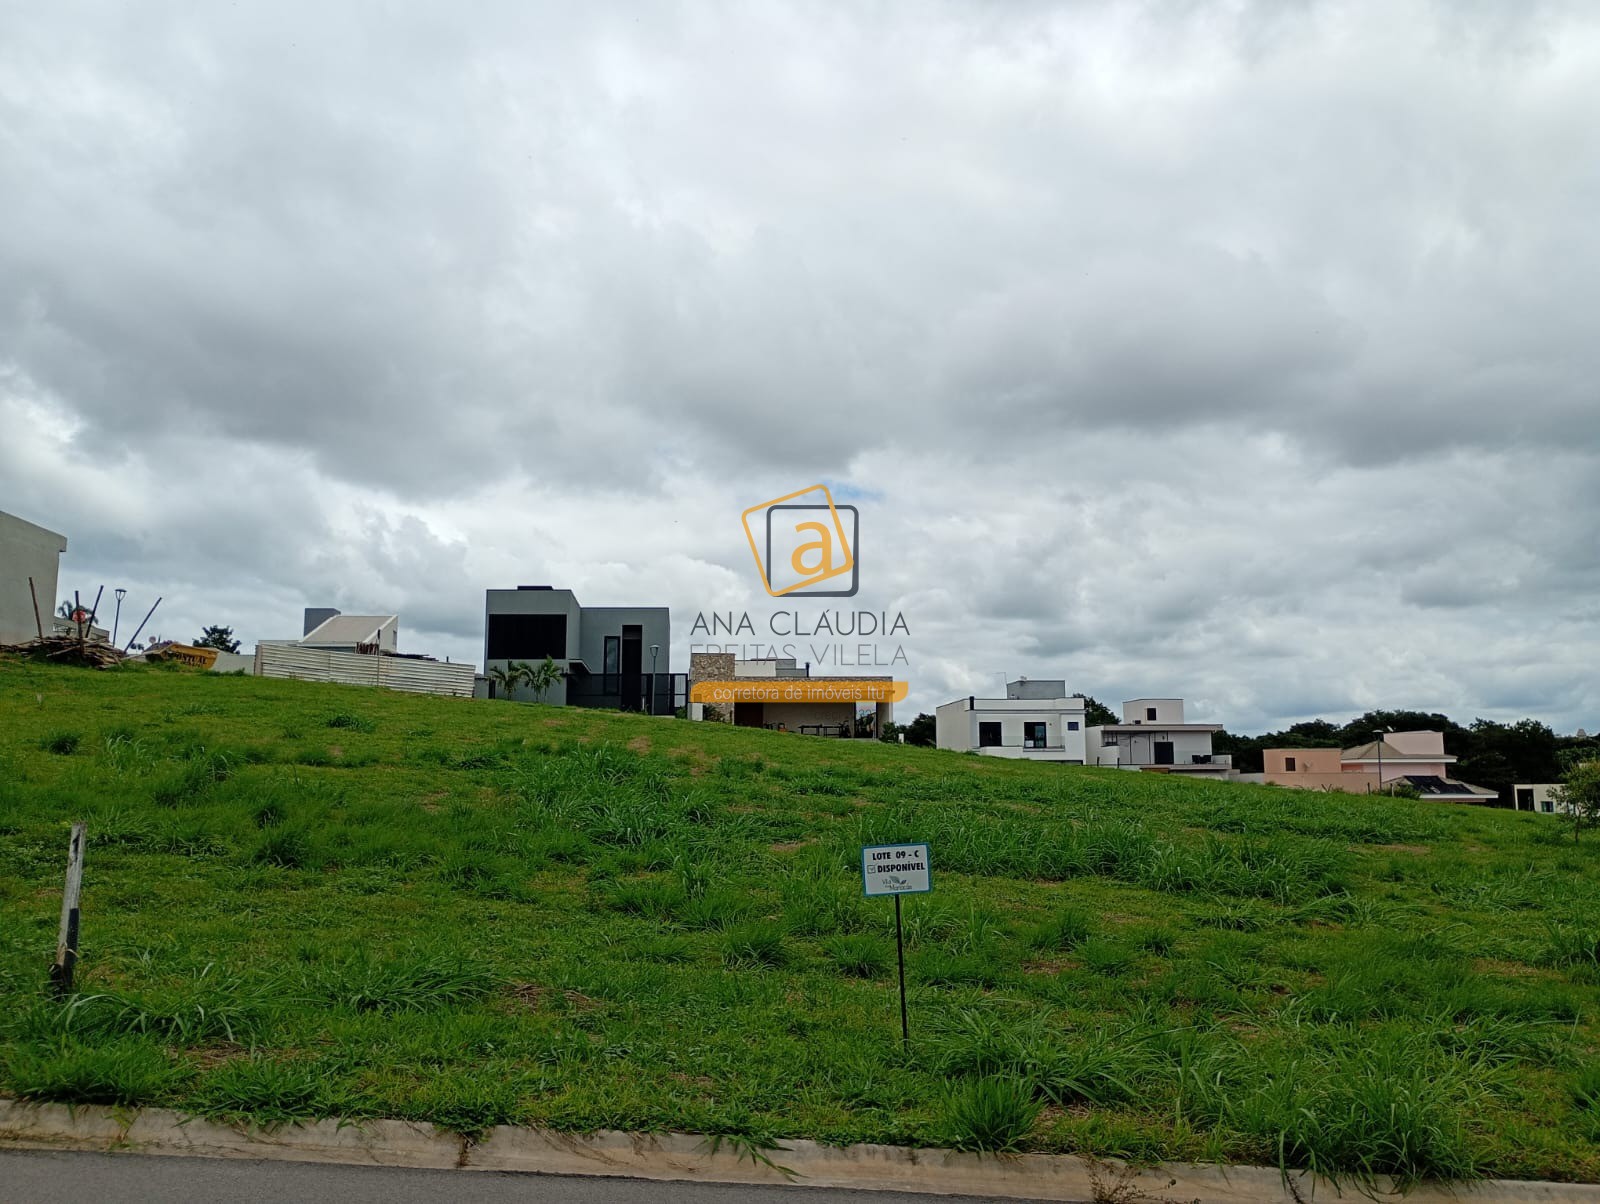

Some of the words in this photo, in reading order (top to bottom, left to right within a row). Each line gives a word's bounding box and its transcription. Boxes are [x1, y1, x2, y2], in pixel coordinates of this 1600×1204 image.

[872, 852, 892, 861] LOTE
[896, 851, 906, 859] 09
[914, 850, 919, 858] C
[877, 861, 926, 873] DISPONÍVEL
